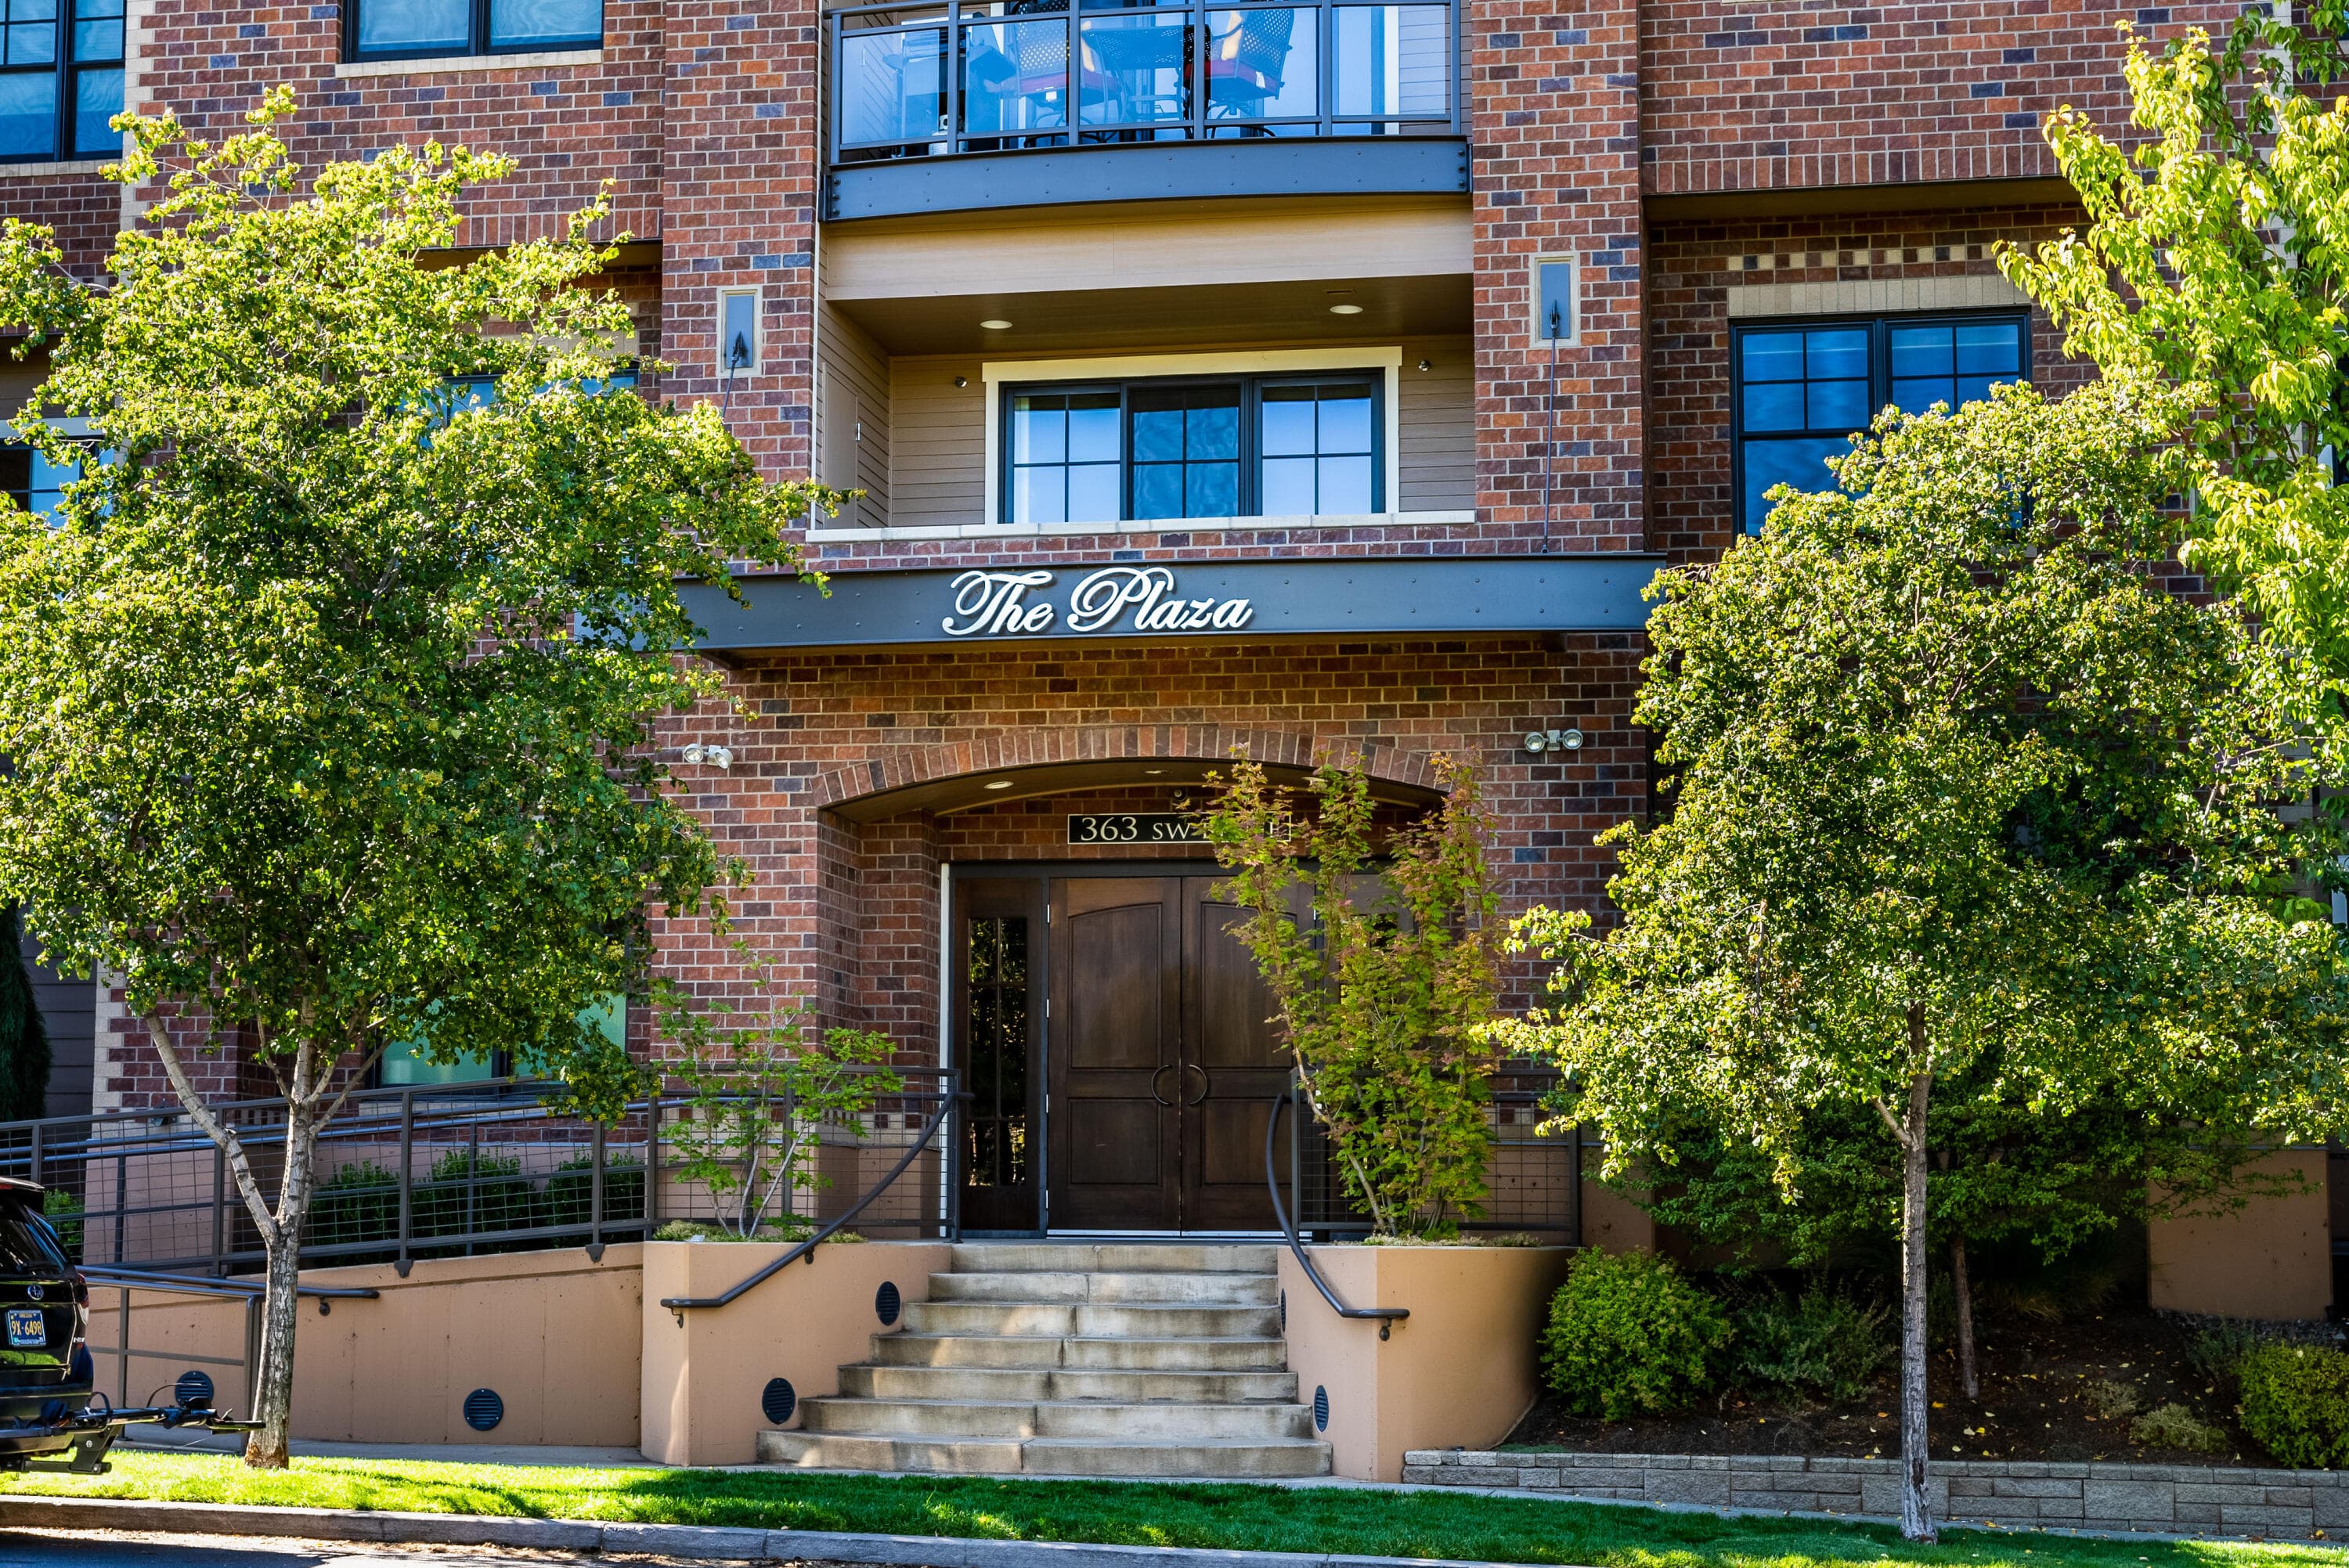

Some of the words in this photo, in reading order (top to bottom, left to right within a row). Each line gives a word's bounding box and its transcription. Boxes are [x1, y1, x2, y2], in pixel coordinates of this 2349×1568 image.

[942, 571, 1054, 636] The
[1067, 567, 1254, 632] Plaza
[1081, 816, 1138, 841] 363
[1152, 822, 1191, 840] SW
